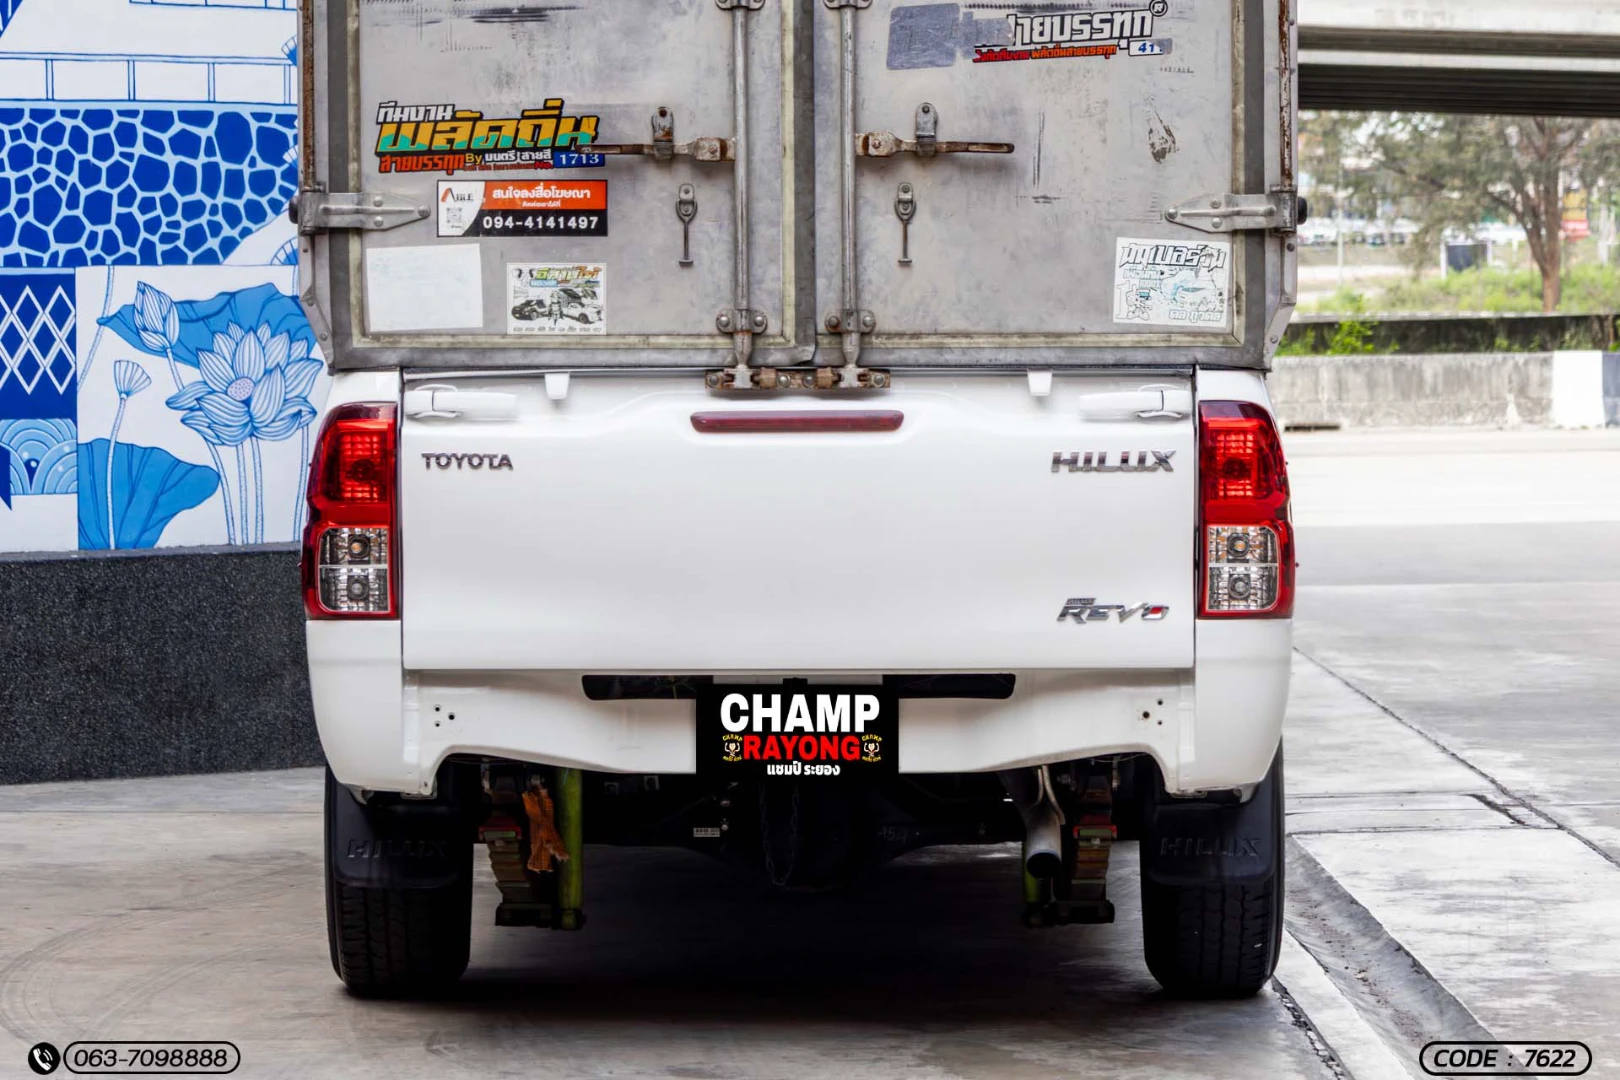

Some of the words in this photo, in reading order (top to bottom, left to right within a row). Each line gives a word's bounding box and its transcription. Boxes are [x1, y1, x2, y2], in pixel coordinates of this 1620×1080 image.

[377, 101, 455, 123] ทีมงาน
[376, 99, 599, 152] พลัดถิ่น
[379, 155, 465, 175] สายบรรทุก
[465, 153, 483, 165] By
[559, 153, 600, 165] 1713
[492, 182, 591, 199] สนใจลงสื่อโฆษณา
[483, 216, 599, 229] 094-4141497
[421, 453, 514, 470] TOYOTA
[1051, 450, 1176, 472] HILUX
[1160, 838, 1260, 857] HILUX
